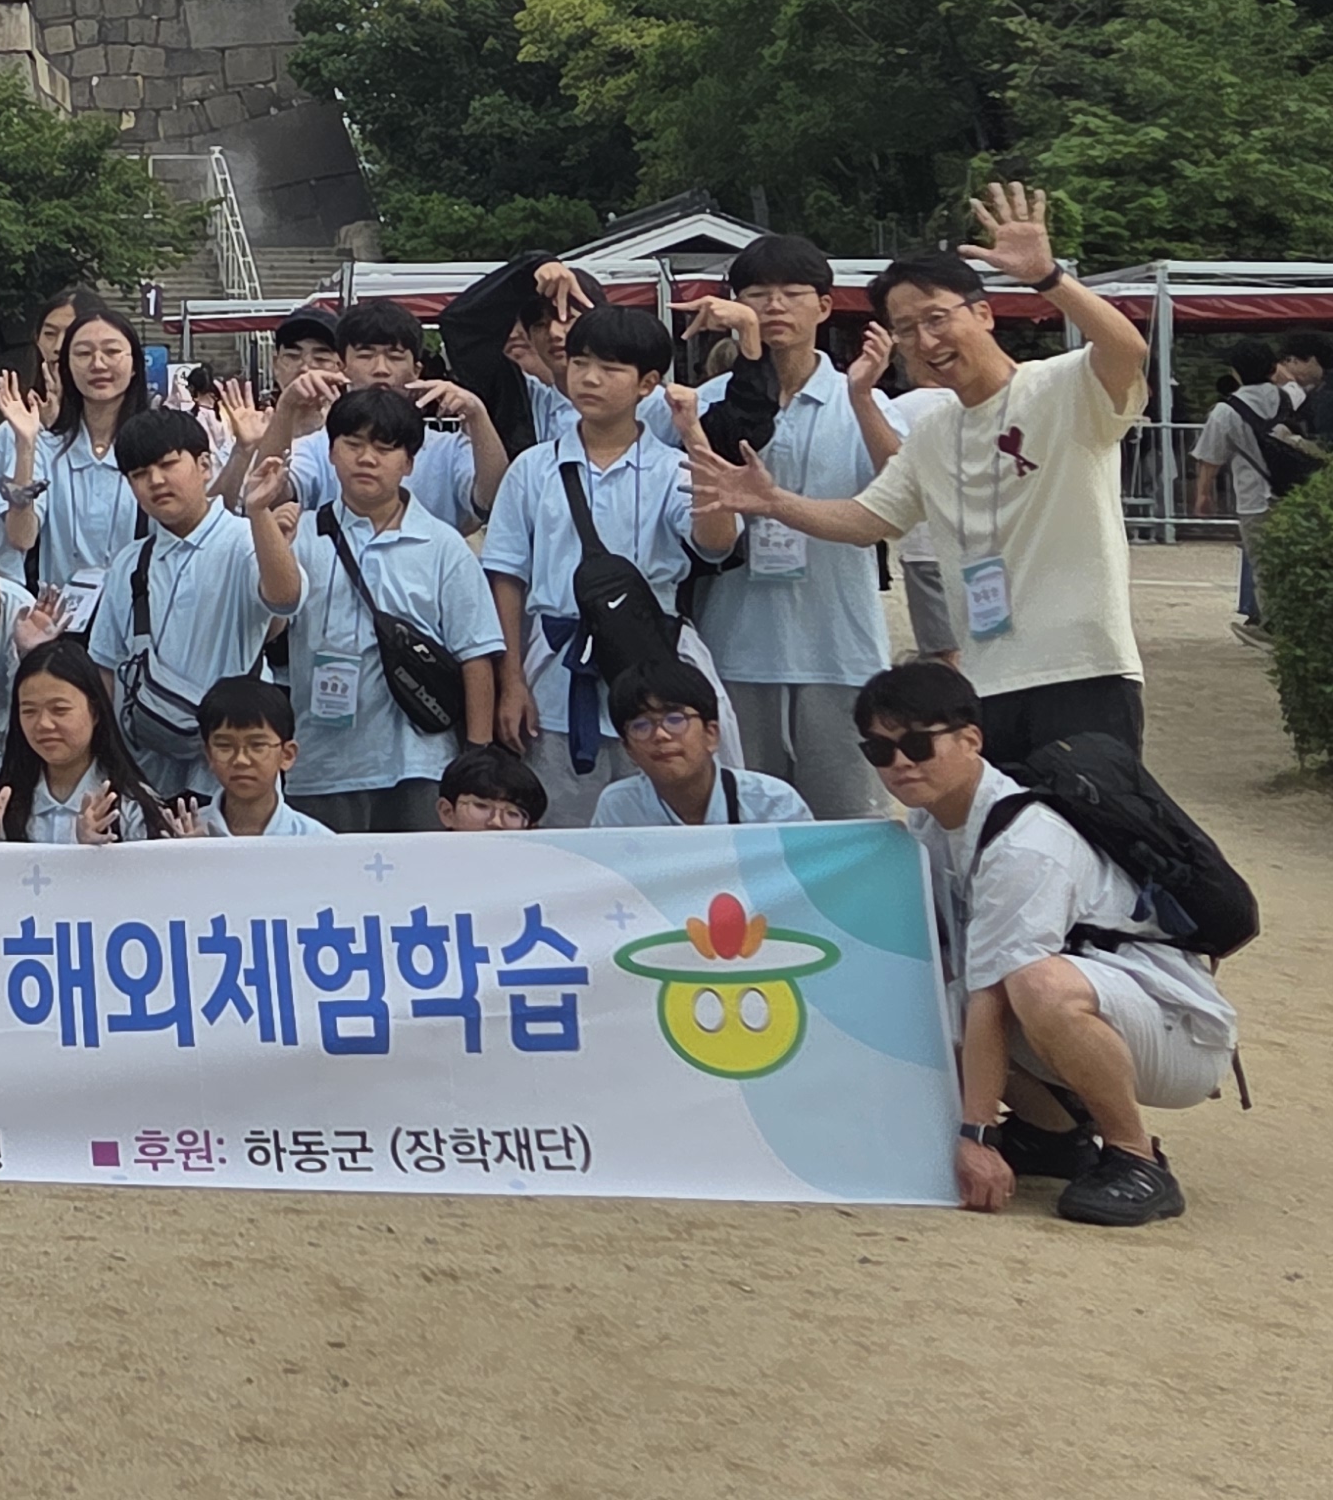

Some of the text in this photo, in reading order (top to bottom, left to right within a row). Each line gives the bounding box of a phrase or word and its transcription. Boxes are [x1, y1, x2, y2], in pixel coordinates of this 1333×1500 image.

[146, 288, 157, 316] 1
[4, 904, 589, 1055] 해외체험학습
[135, 1125, 591, 1173] 후원: 하동군 (장학재단)
